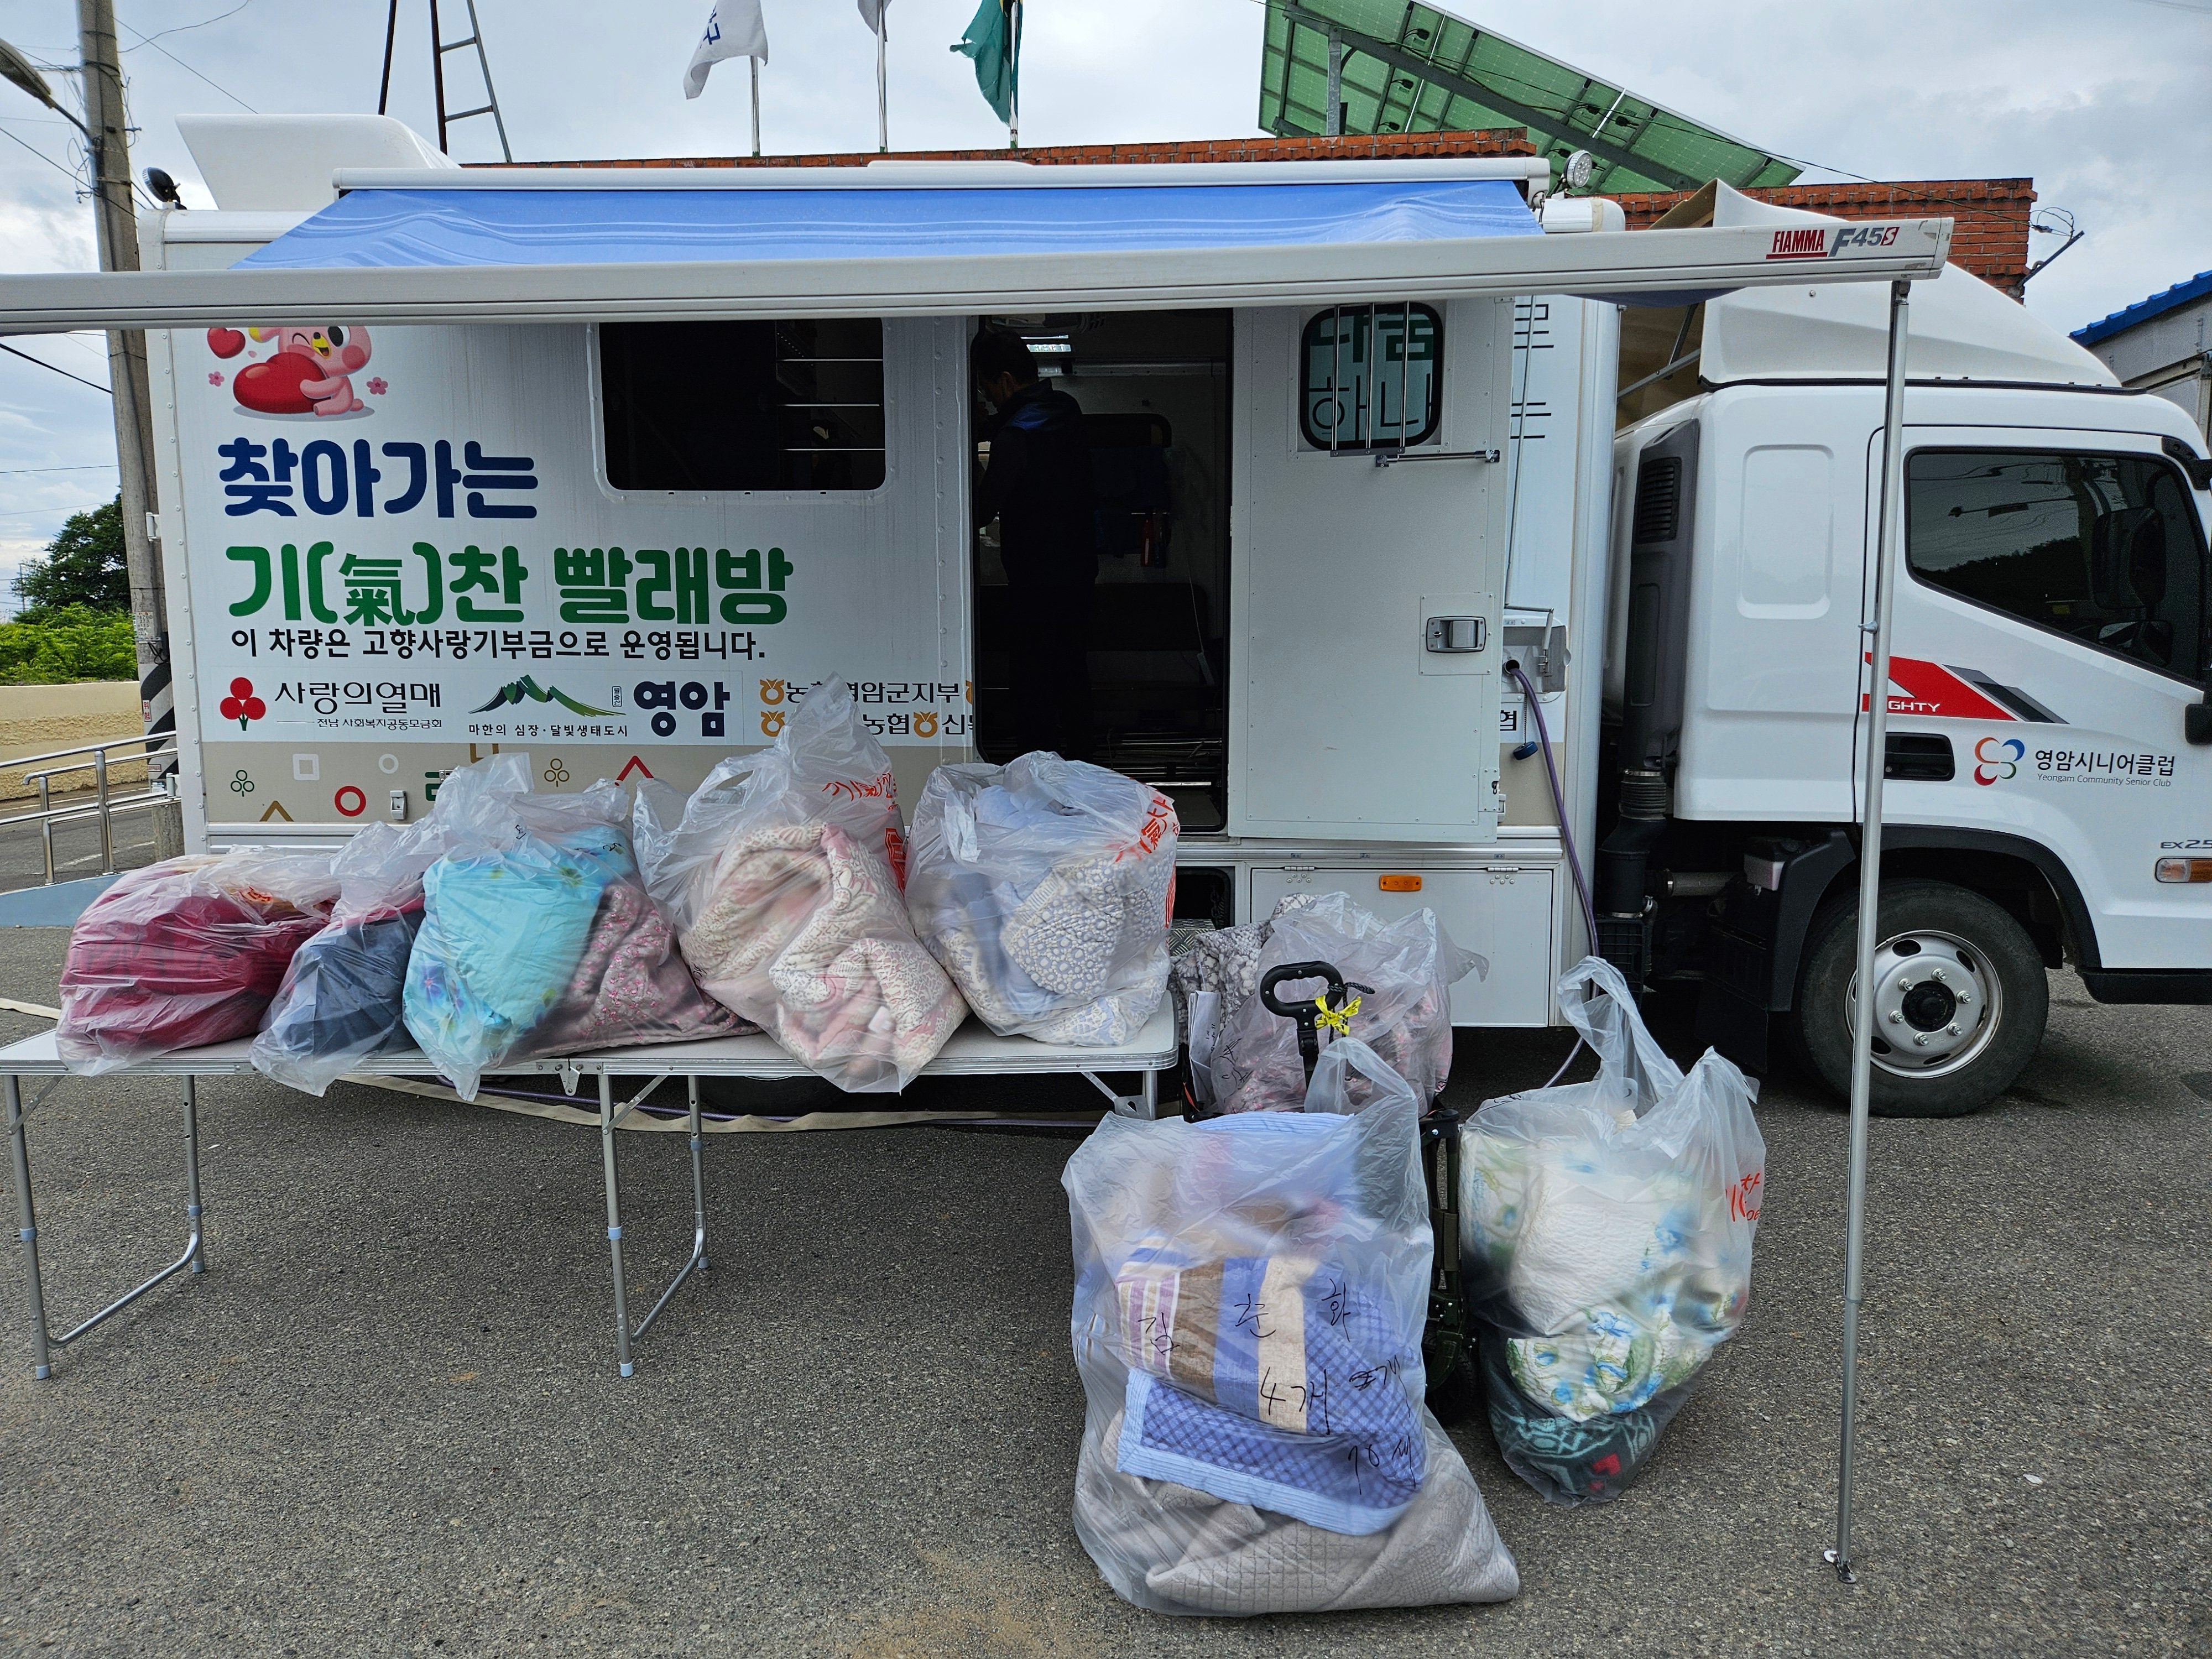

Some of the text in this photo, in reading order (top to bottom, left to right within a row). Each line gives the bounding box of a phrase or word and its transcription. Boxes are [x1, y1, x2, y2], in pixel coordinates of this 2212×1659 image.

[1772, 227, 1900, 257] FIAMMA F45S
[218, 437, 539, 519] 찾아가는
[226, 541, 794, 627] 기(氣)찬 빨래방
[231, 628, 765, 660] 이 차량은 고향사랑기부금으로 운영됩니다.
[274, 681, 441, 715] 사랑의열매
[633, 681, 731, 737] 영암
[1888, 701, 1940, 712] GHTY
[317, 718, 442, 731] 전남 사회복지공동모금회
[468, 724, 507, 737] 마한의
[942, 714, 972, 735] 신
[2035, 749, 2176, 776] 영암시니어클럽
[2037, 773, 2172, 787] Yeongam Community Senior Club
